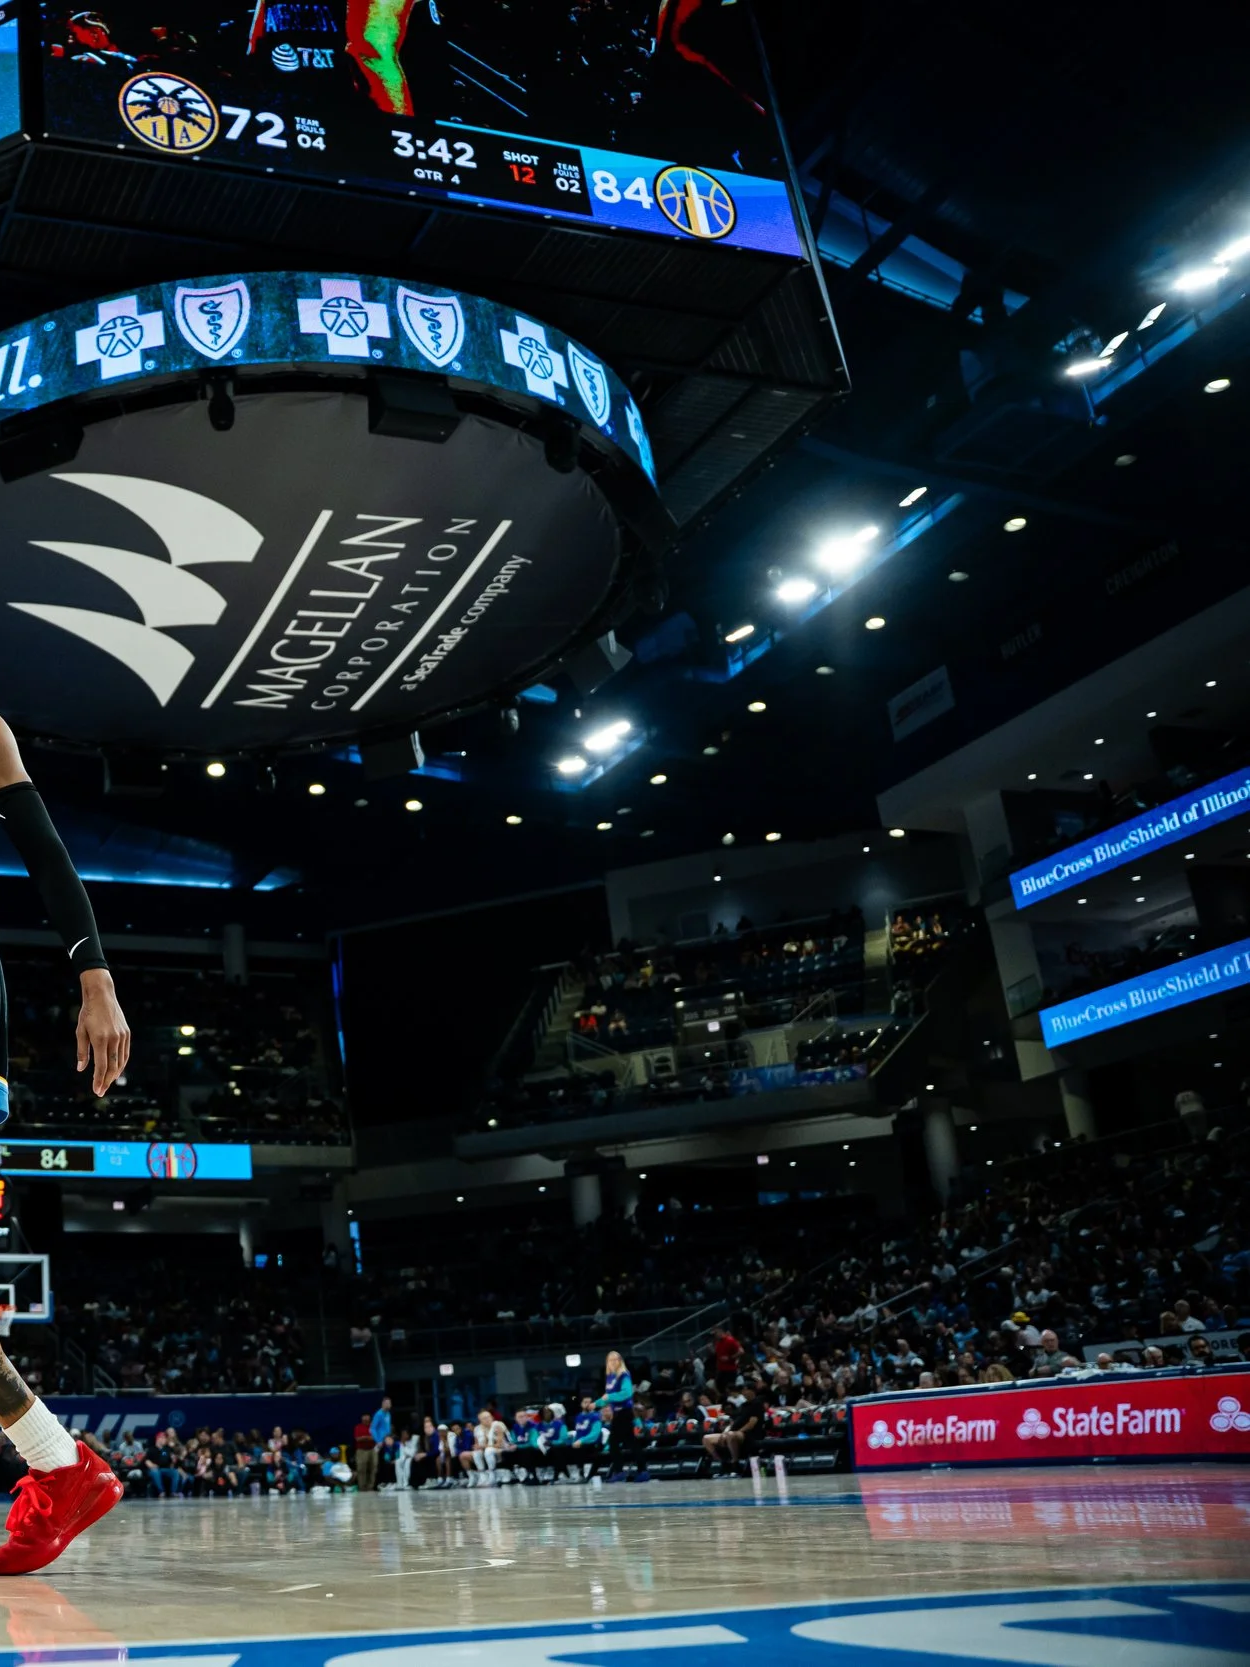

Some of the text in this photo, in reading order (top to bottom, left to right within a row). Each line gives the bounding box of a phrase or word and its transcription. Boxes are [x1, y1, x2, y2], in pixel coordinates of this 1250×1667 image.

[221, 105, 288, 148] 72
[294, 116, 320, 128] TEAM
[295, 124, 326, 135] FOULS
[297, 133, 326, 150] 04
[391, 130, 477, 168] 3:42
[503, 150, 539, 166] SHOT
[556, 162, 579, 173] TEAM
[413, 168, 461, 185] QTR 4
[509, 164, 536, 185] 12
[553, 168, 580, 180] FOULS
[555, 177, 582, 194] 02
[591, 170, 654, 209] 84
[233, 513, 423, 709] MAGELLAN
[311, 518, 477, 710] CORPORATION
[400, 554, 532, 691] a SeaTrade company
[1020, 854, 1094, 896] BlueCross
[1093, 811, 1181, 863] BlueShield
[1181, 802, 1201, 824] of
[1051, 998, 1128, 1033] BlueCross
[1127, 962, 1221, 1009] BlueShield
[1223, 955, 1243, 977] of
[40, 1149, 69, 1169] 84
